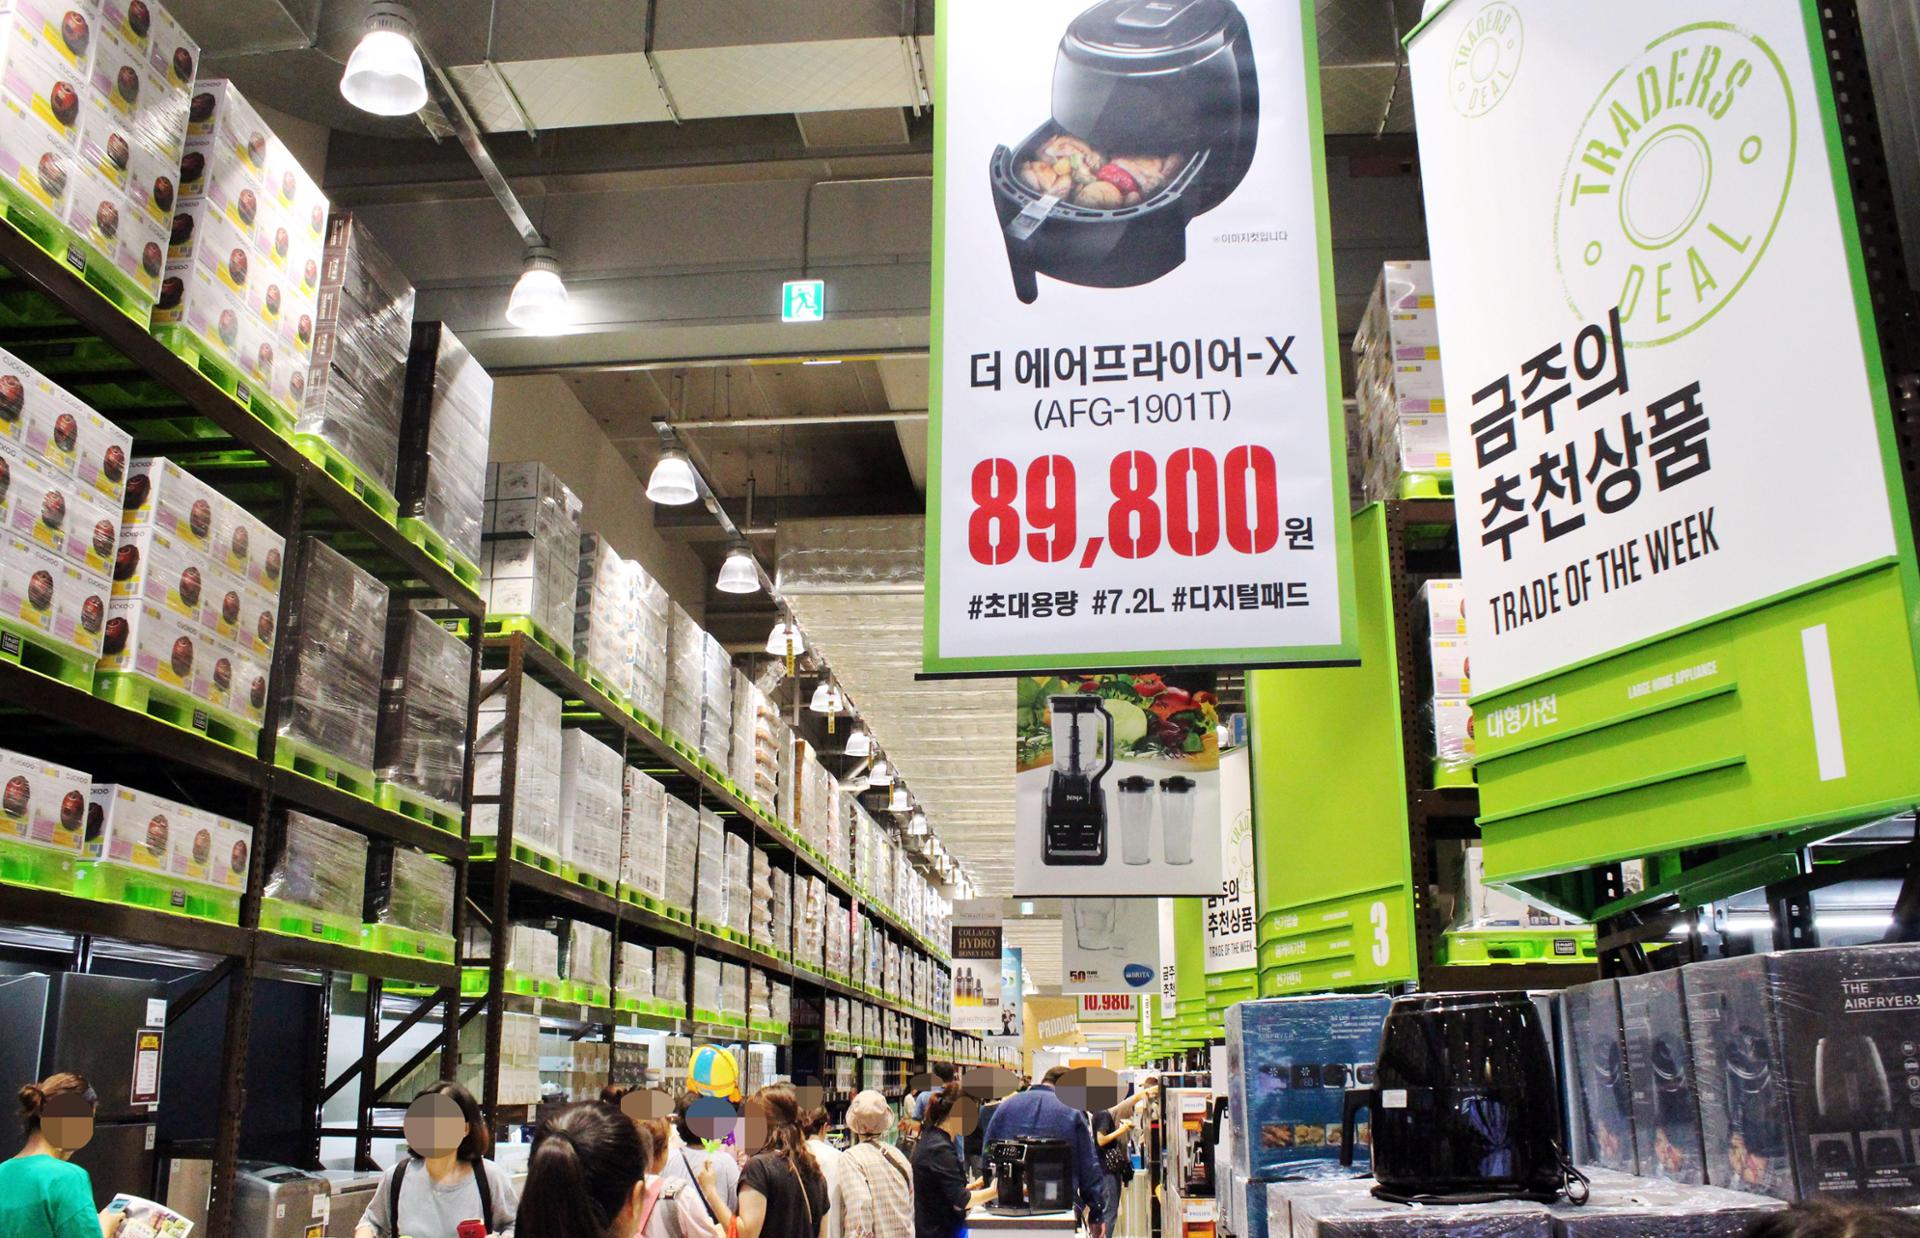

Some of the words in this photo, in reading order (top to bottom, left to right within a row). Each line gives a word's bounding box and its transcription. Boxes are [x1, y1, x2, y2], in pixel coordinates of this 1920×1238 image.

[1455, 9, 1511, 70] TRADERS
[1570, 44, 1753, 206] TRADERS
[1617, 222, 1752, 324] DEAL
[969, 350, 1001, 392] 더
[1014, 335, 1298, 390] 에어프라이어-X
[1470, 305, 1630, 469] 금주의
[1034, 389, 1232, 431] (AFG-1901T)
[1481, 380, 1712, 562] 추천상품
[1489, 572, 1562, 636] TRADE
[1565, 558, 1593, 606] OF
[1596, 539, 1642, 595] THE
[1644, 507, 1720, 576] WEEK
[967, 590, 1079, 620] #초대용량
[1091, 588, 1165, 616] #7.2L
[1172, 582, 1309, 613] #디지털패드
[1487, 693, 1558, 738] 대형가전
[1230, 814, 1252, 848] TRAD
[959, 938, 996, 949] HYDRO
[1208, 906, 1253, 938] 추천상품
[1370, 901, 1390, 967] 3
[1069, 970, 1086, 983] 50
[1841, 983, 1869, 994] THE
[1038, 1015, 1076, 1040] PRODUC
